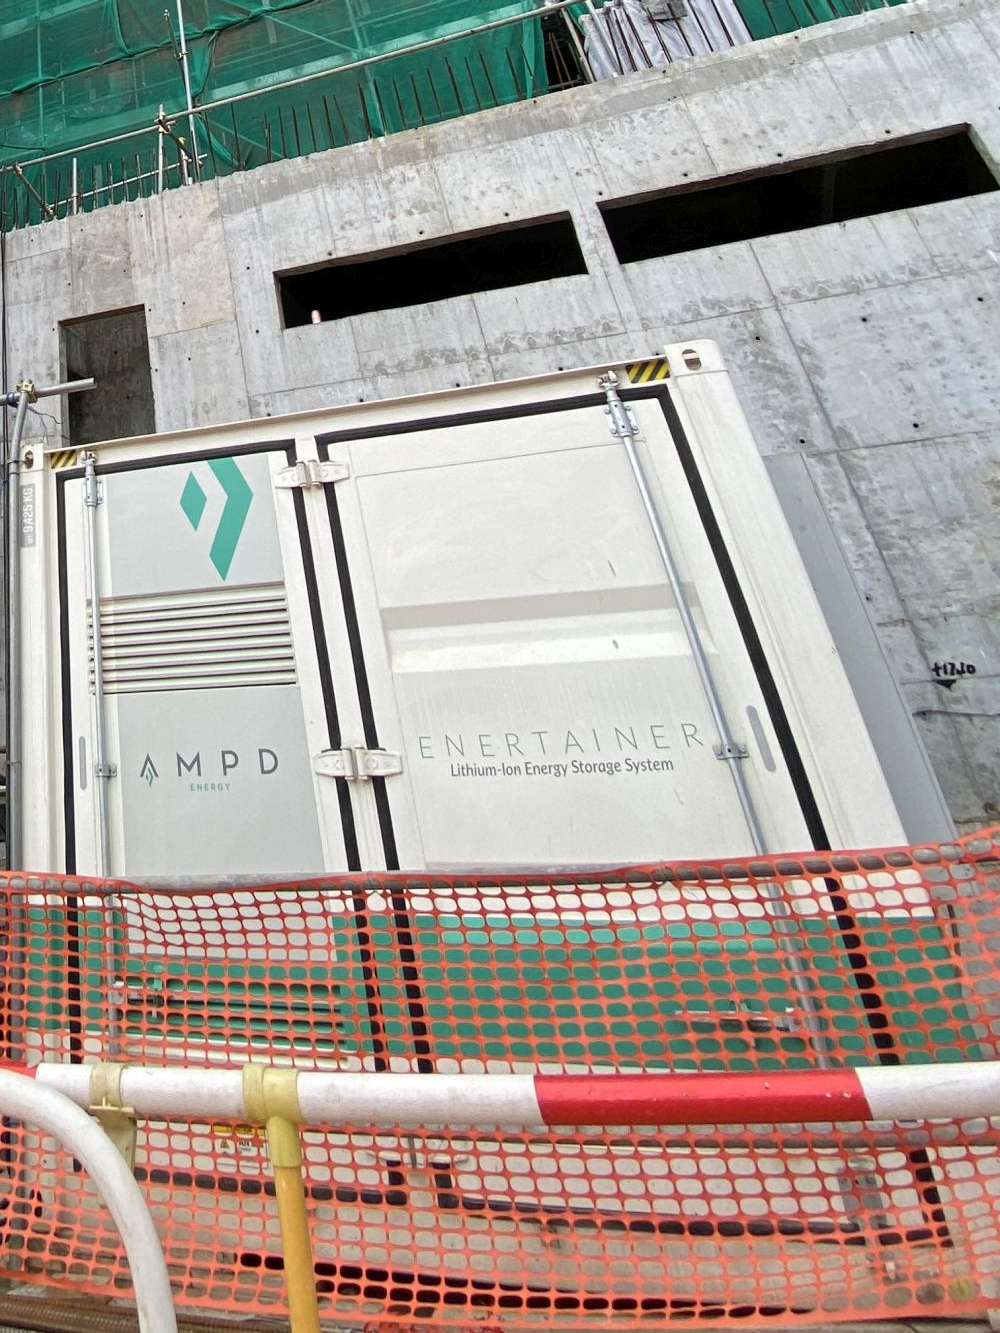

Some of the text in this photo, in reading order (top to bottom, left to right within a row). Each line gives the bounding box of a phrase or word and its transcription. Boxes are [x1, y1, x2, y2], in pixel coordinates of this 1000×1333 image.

[22, 488, 33, 502] KG
[417, 723, 705, 759] ENERTAINER
[139, 747, 279, 778] AMPD
[450, 757, 674, 778] Lithium-Ion Energy Storage System
[190, 783, 231, 792] ENERGY
